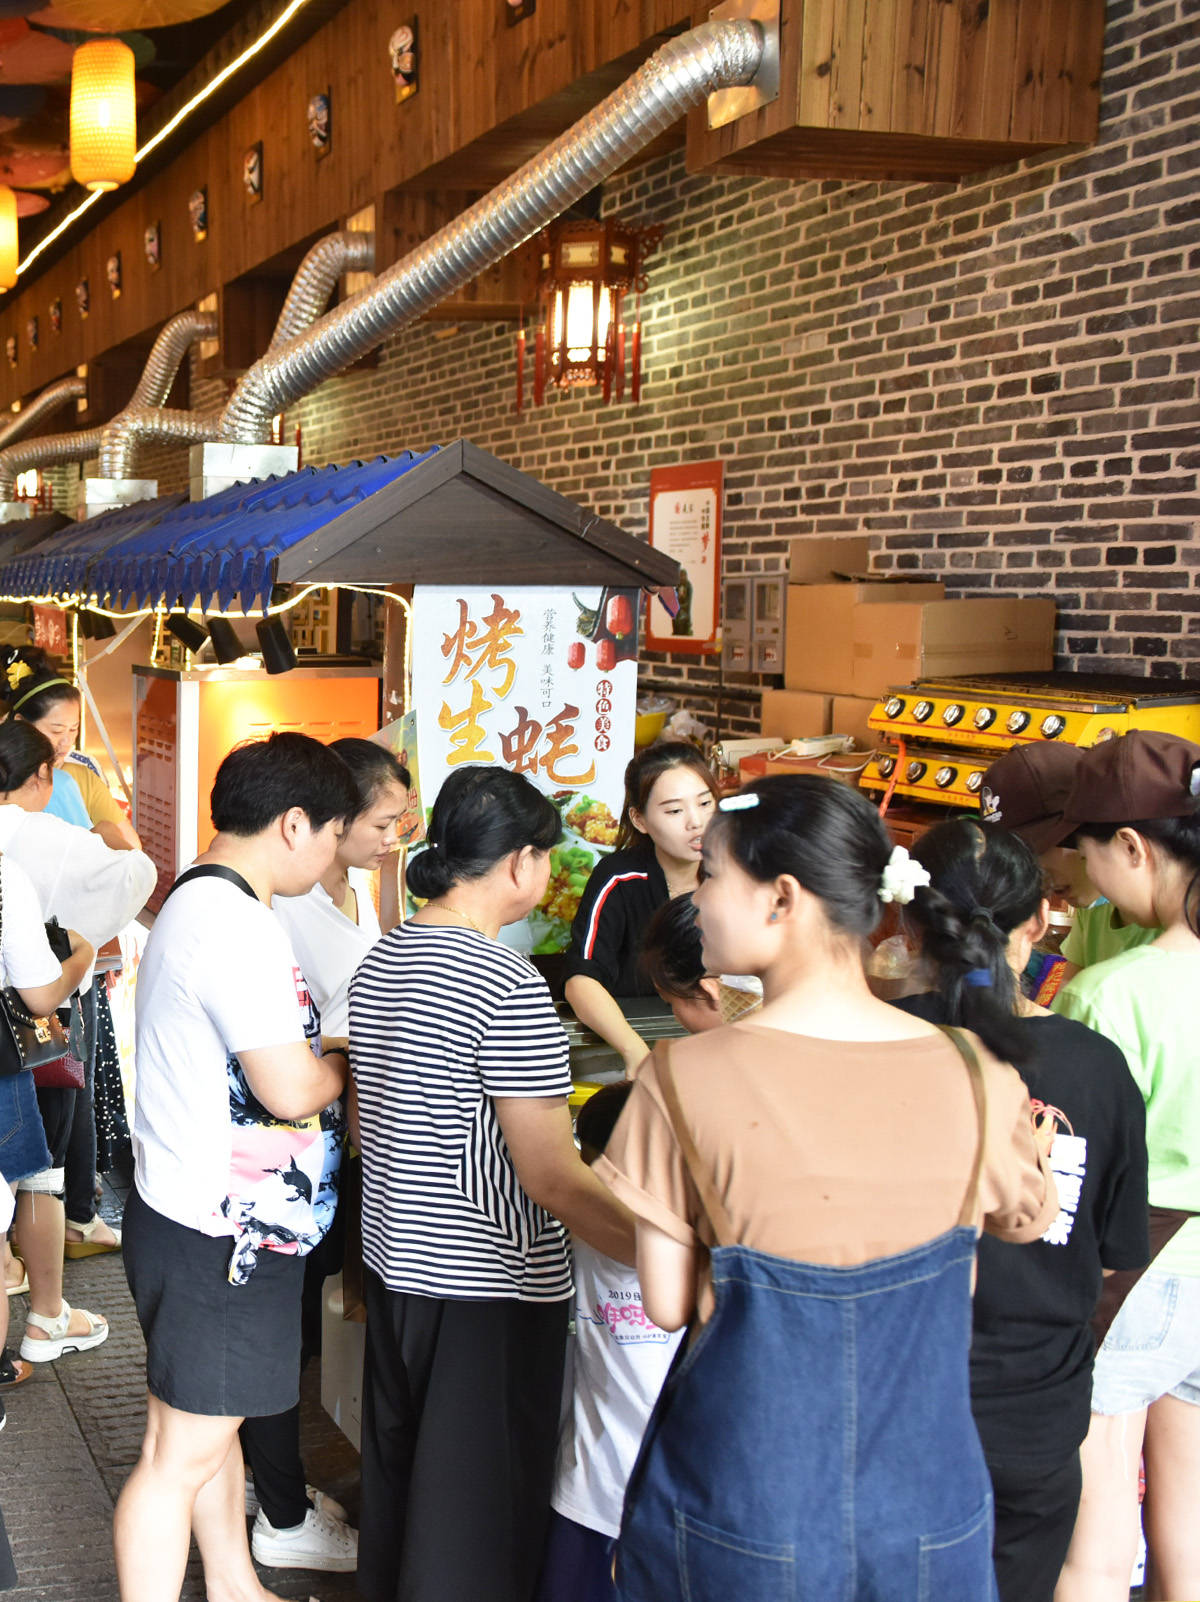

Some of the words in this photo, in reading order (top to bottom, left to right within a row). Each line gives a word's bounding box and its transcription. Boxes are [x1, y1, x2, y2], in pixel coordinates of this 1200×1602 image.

[540, 608, 558, 656] 营养健康
[539, 663, 555, 708] 美味可口
[594, 679, 613, 752] 特色美食
